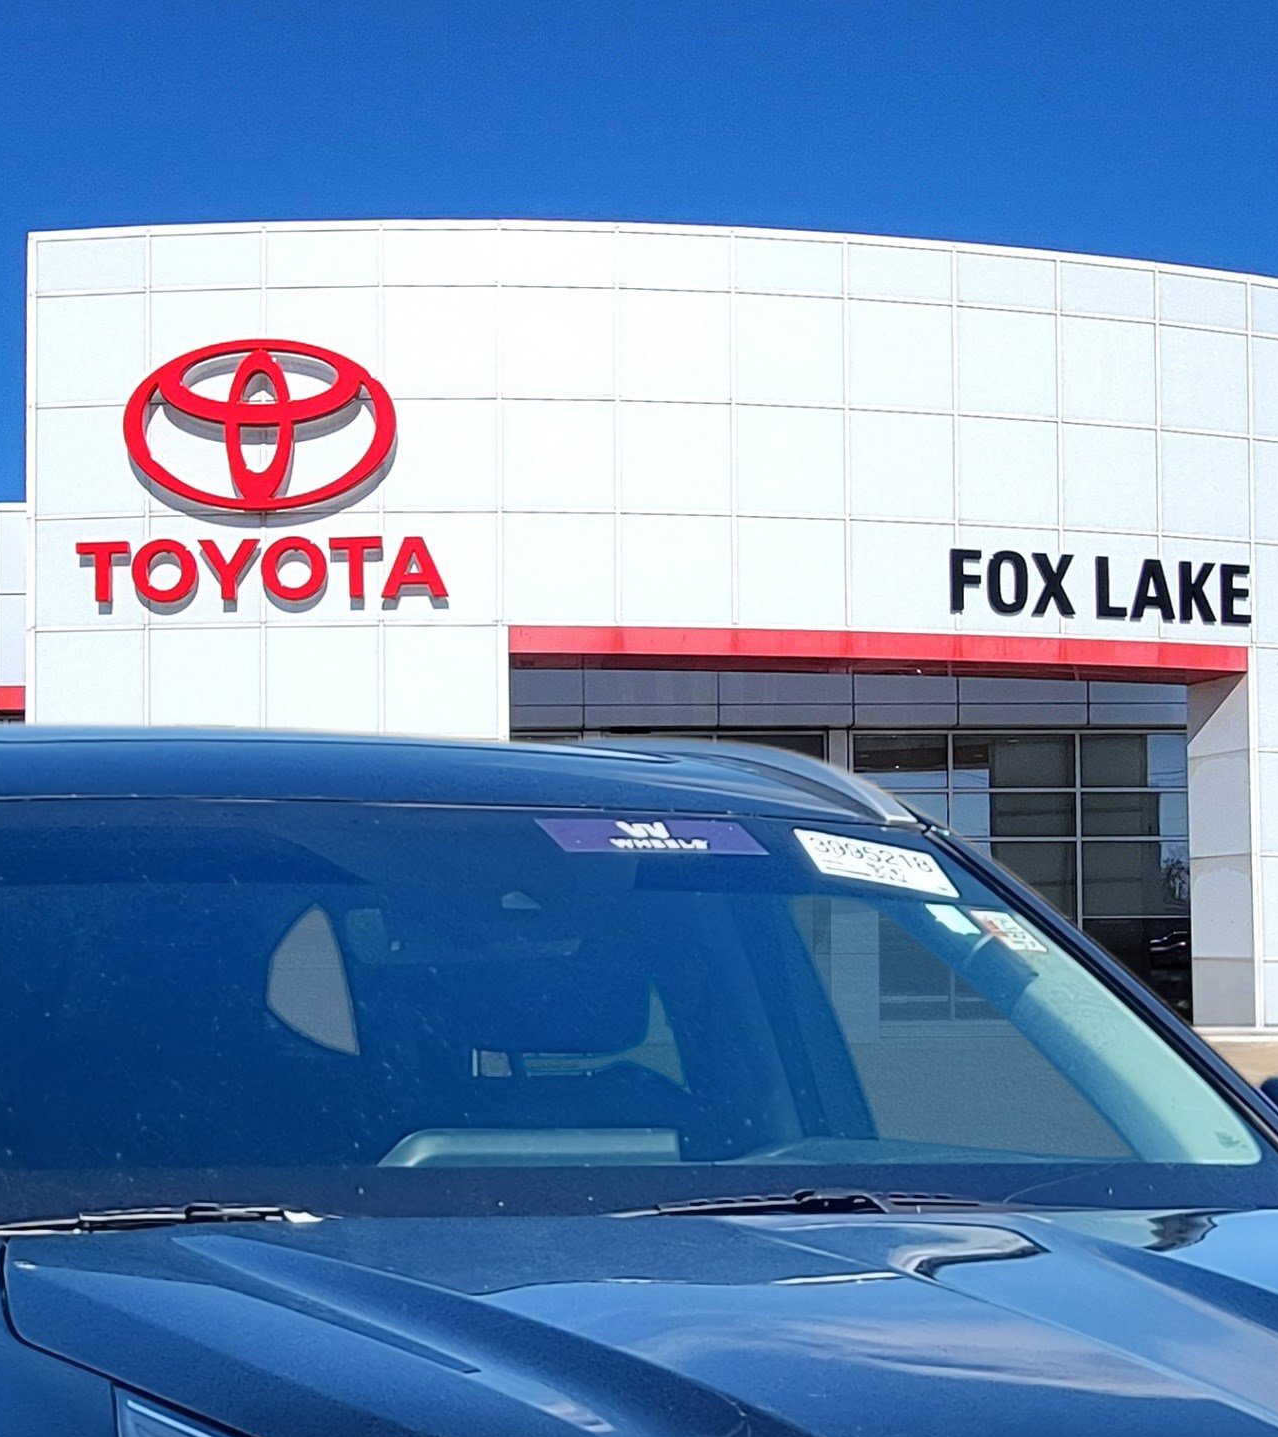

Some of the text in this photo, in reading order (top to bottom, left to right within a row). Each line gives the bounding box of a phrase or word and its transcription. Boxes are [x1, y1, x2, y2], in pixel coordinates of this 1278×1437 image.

[75, 536, 450, 614] TOYOTA
[949, 548, 1252, 626] FOX LAKE
